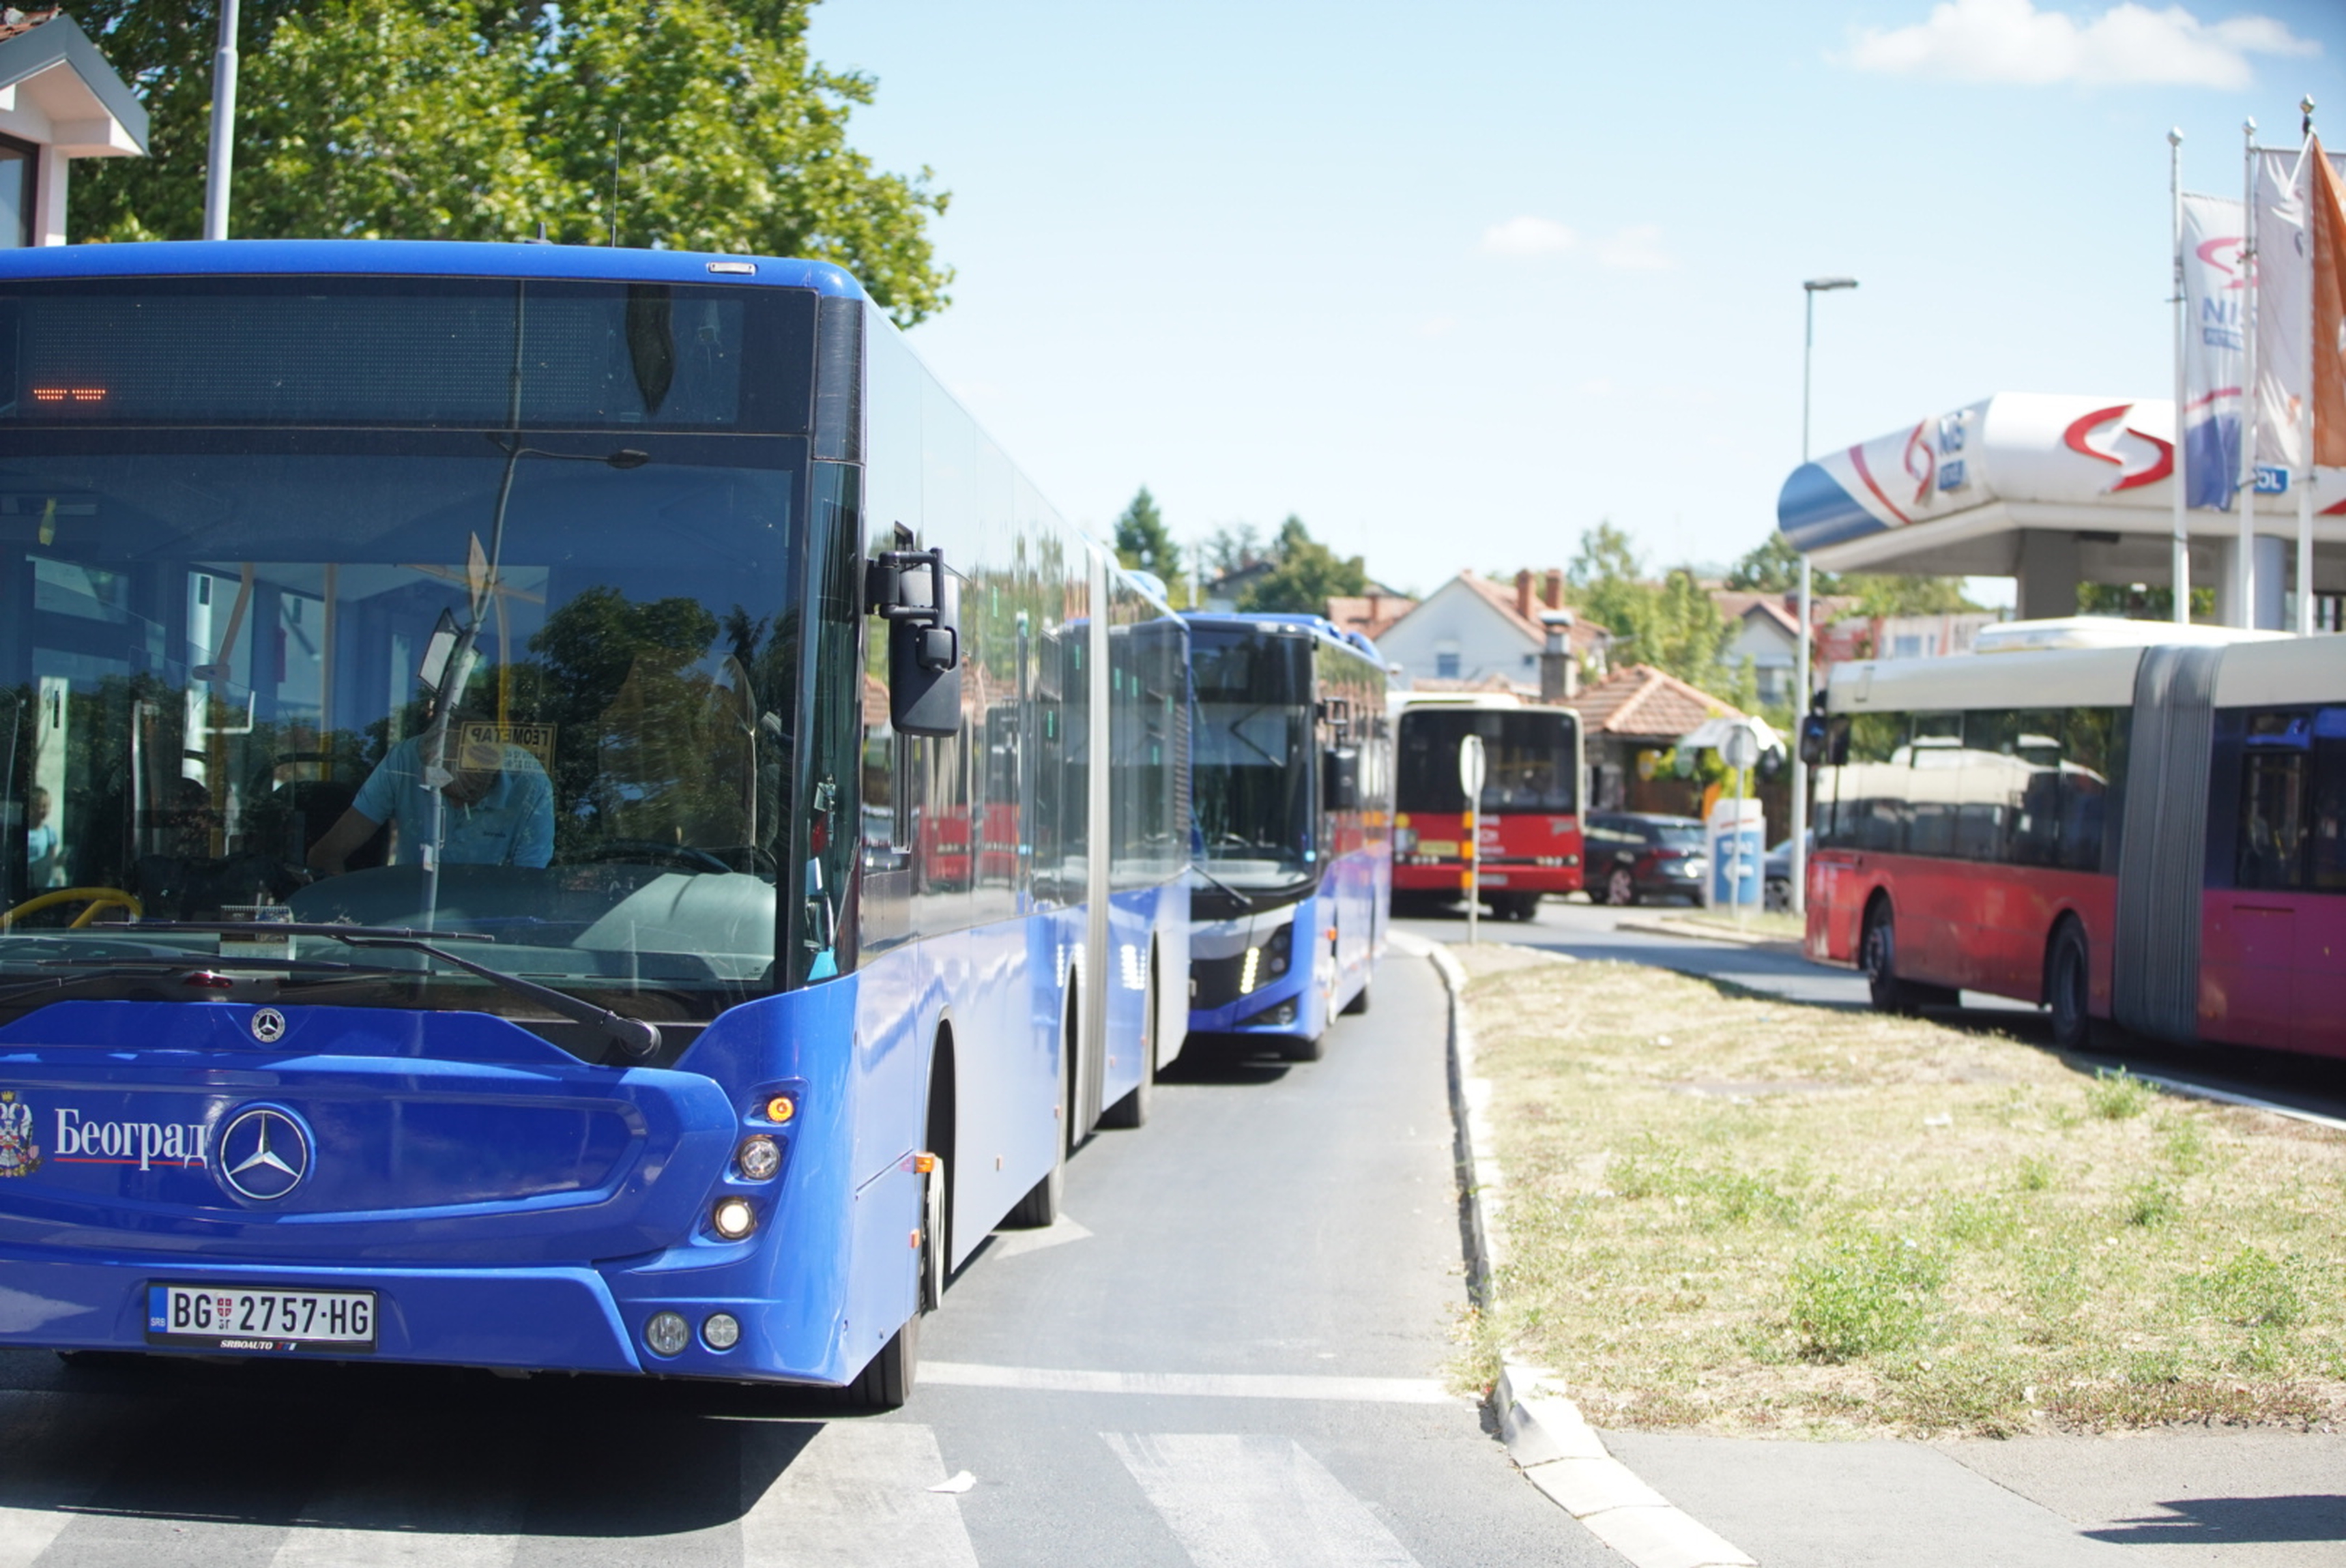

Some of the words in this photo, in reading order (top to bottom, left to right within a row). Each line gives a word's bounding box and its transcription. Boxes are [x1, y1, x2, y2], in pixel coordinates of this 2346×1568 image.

[54, 1109, 208, 1170] Београд
[151, 1317, 166, 1327] SRB
[174, 1293, 211, 1328] BG
[220, 1339, 273, 1350] SRBOAUTO
